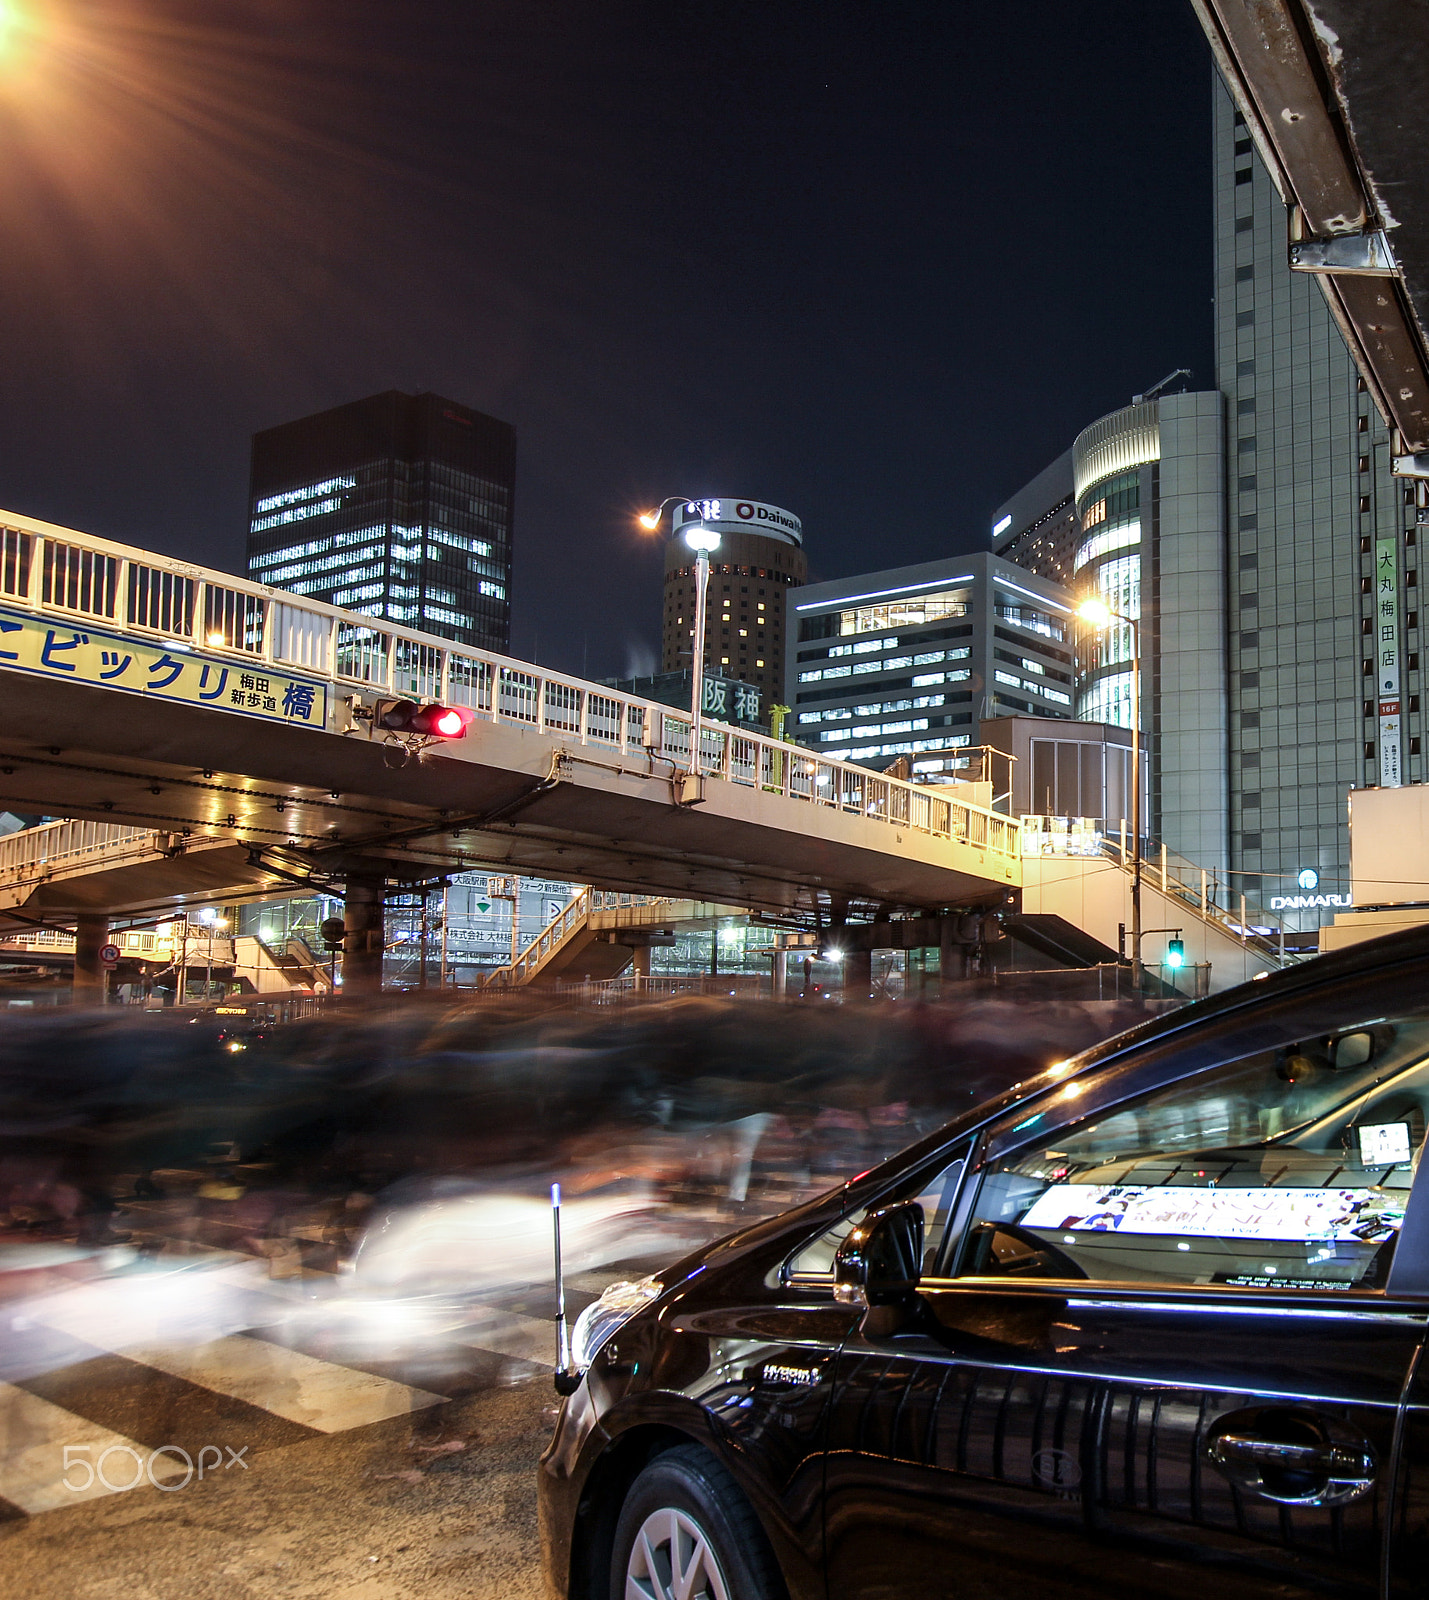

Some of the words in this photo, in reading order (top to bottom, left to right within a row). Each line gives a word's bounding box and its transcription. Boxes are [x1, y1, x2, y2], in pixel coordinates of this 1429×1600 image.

[757, 507, 794, 529] Daiwa
[1380, 552, 1395, 666] 大丸梅田店
[240, 674, 270, 693] 梅田
[231, 688, 278, 712] 新歩道
[281, 681, 316, 720] 橋
[702, 678, 760, 722] 阪神
[1270, 893, 1352, 910] DAIMARU
[450, 929, 484, 941] 株式会社
